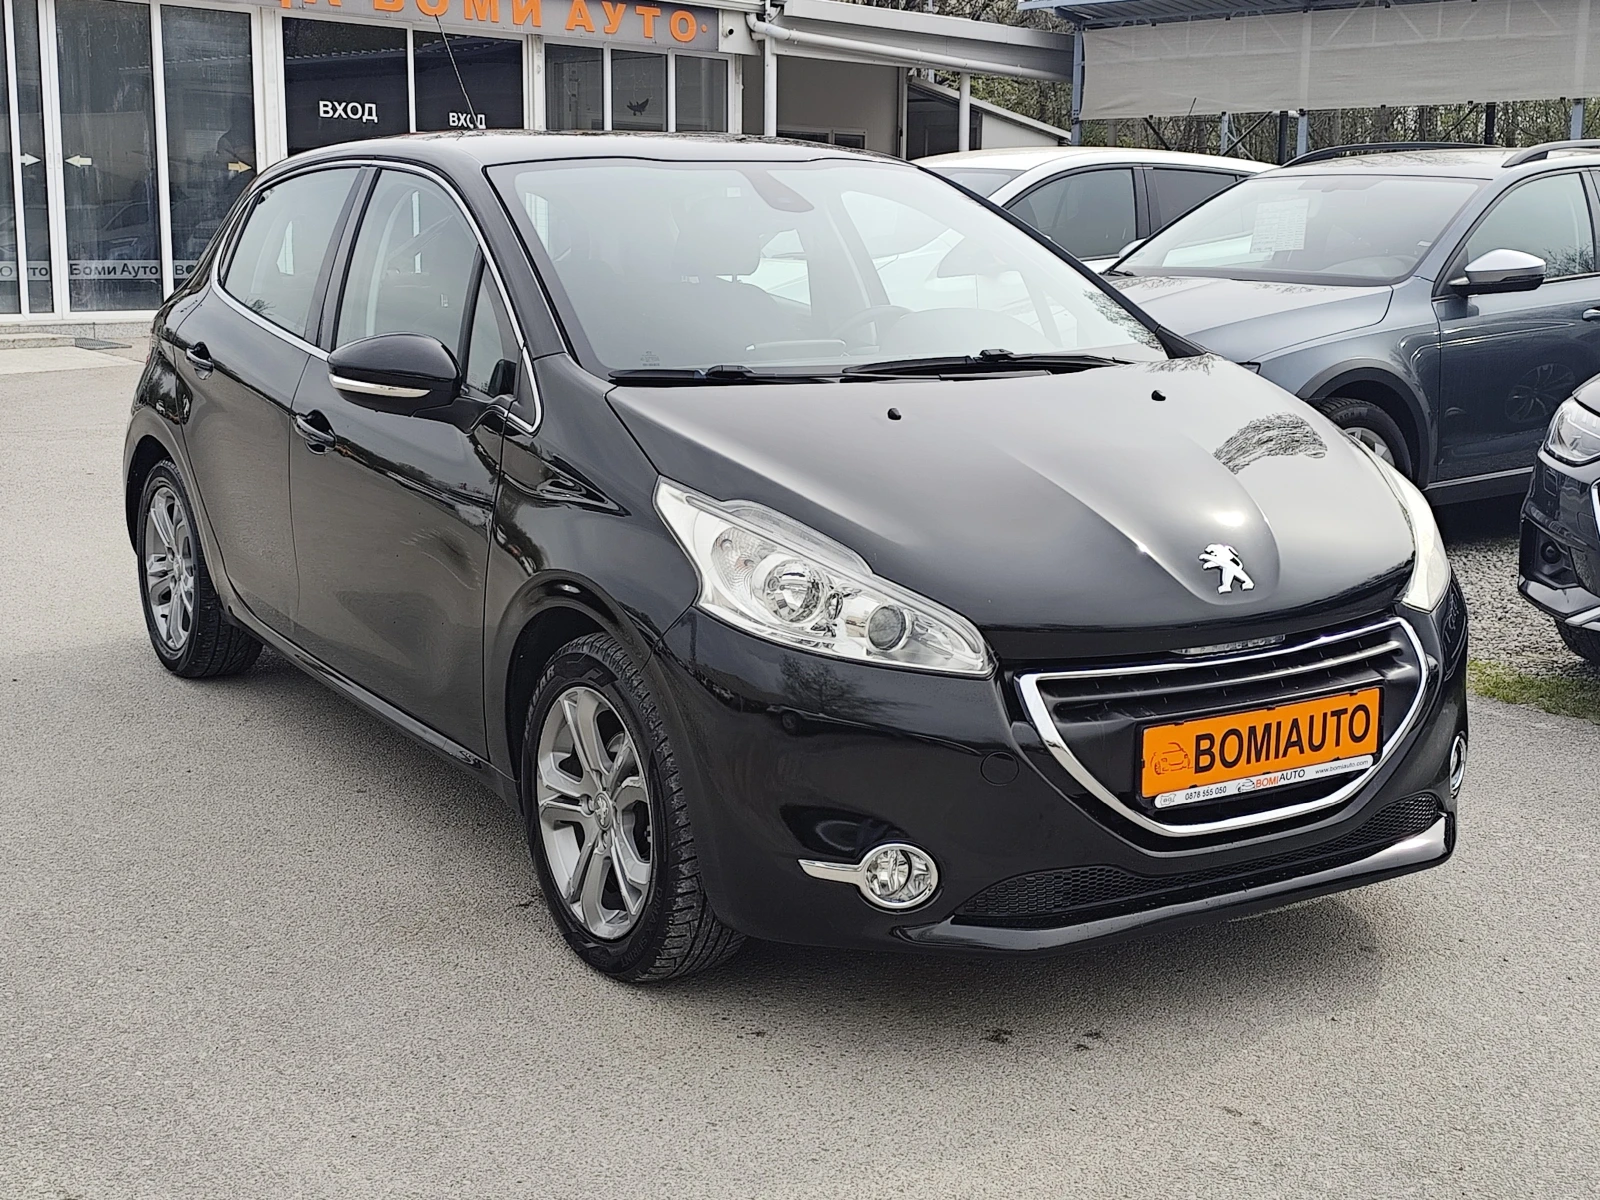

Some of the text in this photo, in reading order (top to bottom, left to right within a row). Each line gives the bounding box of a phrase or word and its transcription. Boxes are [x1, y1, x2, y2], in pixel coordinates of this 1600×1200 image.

[565, 0, 697, 43] АУТО
[318, 100, 378, 123] ВХОД
[448, 112, 486, 129] ВХОД
[69, 263, 159, 278] Боми Ауто
[1194, 704, 1370, 774] BOMIAUTO
[1185, 791, 1200, 800] 0878
[1202, 788, 1213, 797] 555
[1215, 786, 1227, 794] 050
[1315, 759, 1369, 774] www.bomiauto.com
